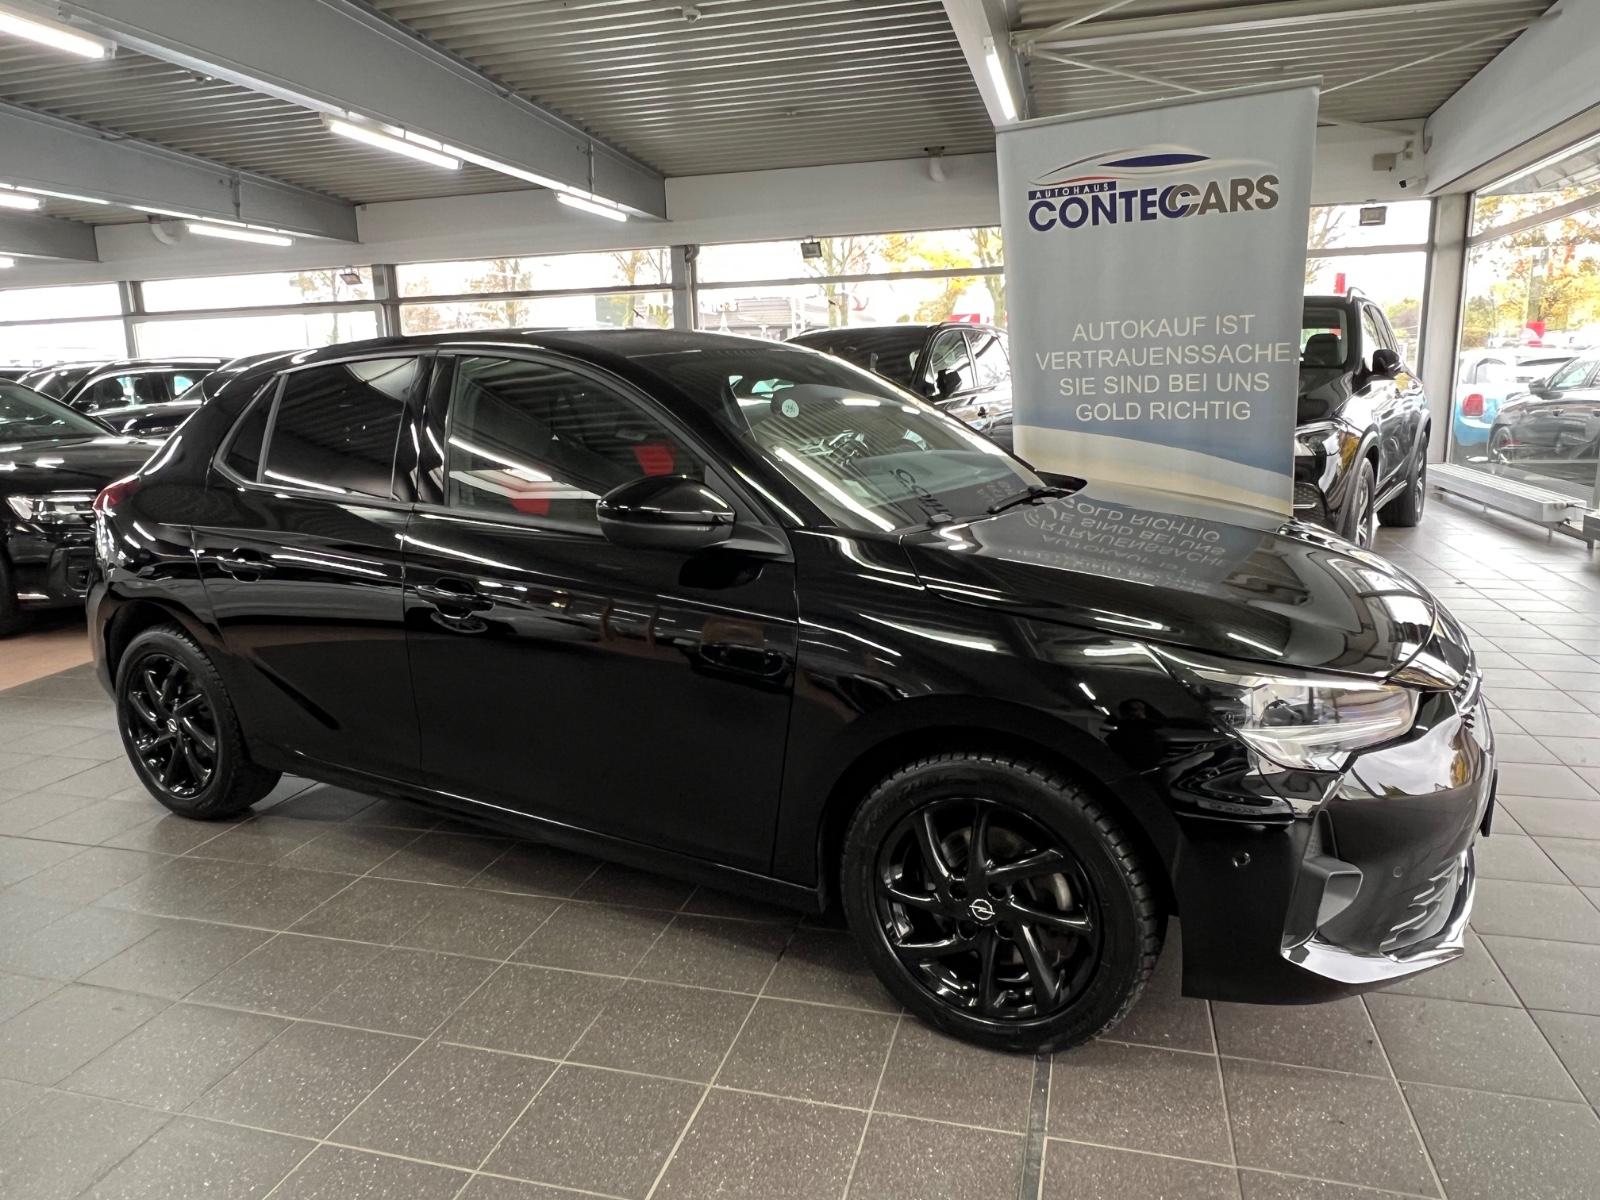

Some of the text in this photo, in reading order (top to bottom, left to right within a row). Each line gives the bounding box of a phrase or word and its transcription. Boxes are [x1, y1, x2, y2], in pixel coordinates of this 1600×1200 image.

[1034, 183, 1110, 198] AUTOHAUS
[1072, 314, 1256, 342] AUTOKAUF IST
[1059, 372, 1270, 396] SIE SIND BEI UNS
[1075, 401, 1251, 422] GOLD RICHTIG
